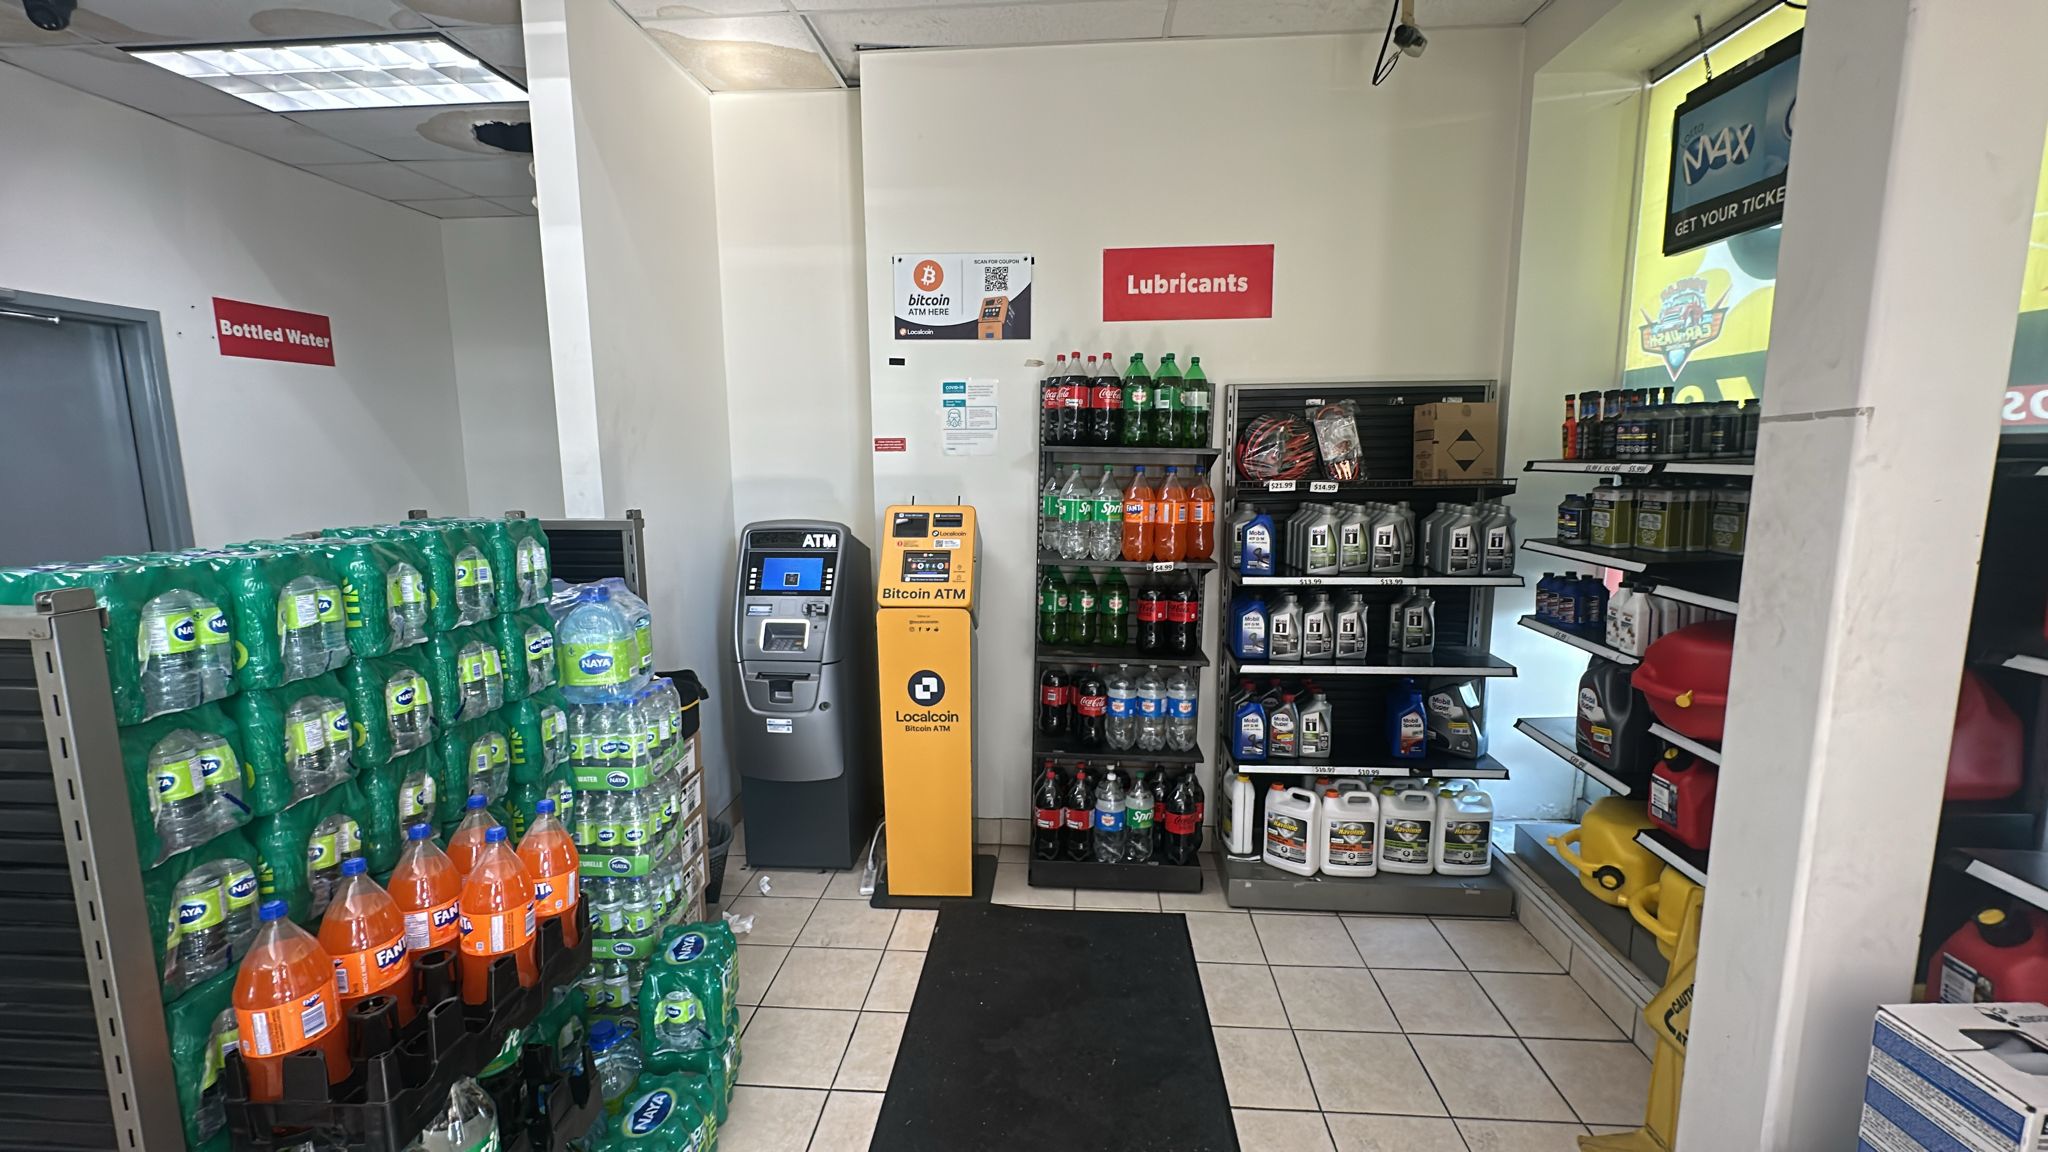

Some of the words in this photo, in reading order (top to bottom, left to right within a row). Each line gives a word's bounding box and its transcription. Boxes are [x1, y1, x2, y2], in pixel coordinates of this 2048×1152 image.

[1682, 123, 1754, 185] MAX
[1674, 216, 1698, 236] GET
[1700, 203, 1738, 228] YOUR
[1742, 186, 1786, 215] TICKE
[1127, 273, 1249, 295] Lubricants
[908, 294, 950, 306] bitcoin
[908, 308, 927, 316] ATM
[928, 308, 949, 316] HERE
[219, 319, 284, 343] Bottled
[285, 328, 330, 349] Water
[1101, 502, 1123, 515] Spri
[802, 534, 836, 548] ATM
[882, 588, 931, 600] Bitcoin
[934, 588, 966, 600] ATM
[581, 658, 611, 668] NAYA
[1432, 696, 1450, 705] Mobil
[896, 711, 959, 722] Localcoin
[577, 775, 597, 783] WATER
[1133, 810, 1154, 822] Spri
[1273, 820, 1298, 832] Havoline
[1394, 825, 1422, 834] Havoline
[180, 906, 203, 917] AYA
[433, 901, 460, 928] FAN
[679, 935, 697, 960] NAYA
[1671, 982, 1695, 1015] CAUTI
[636, 1094, 667, 1130] NAYA
